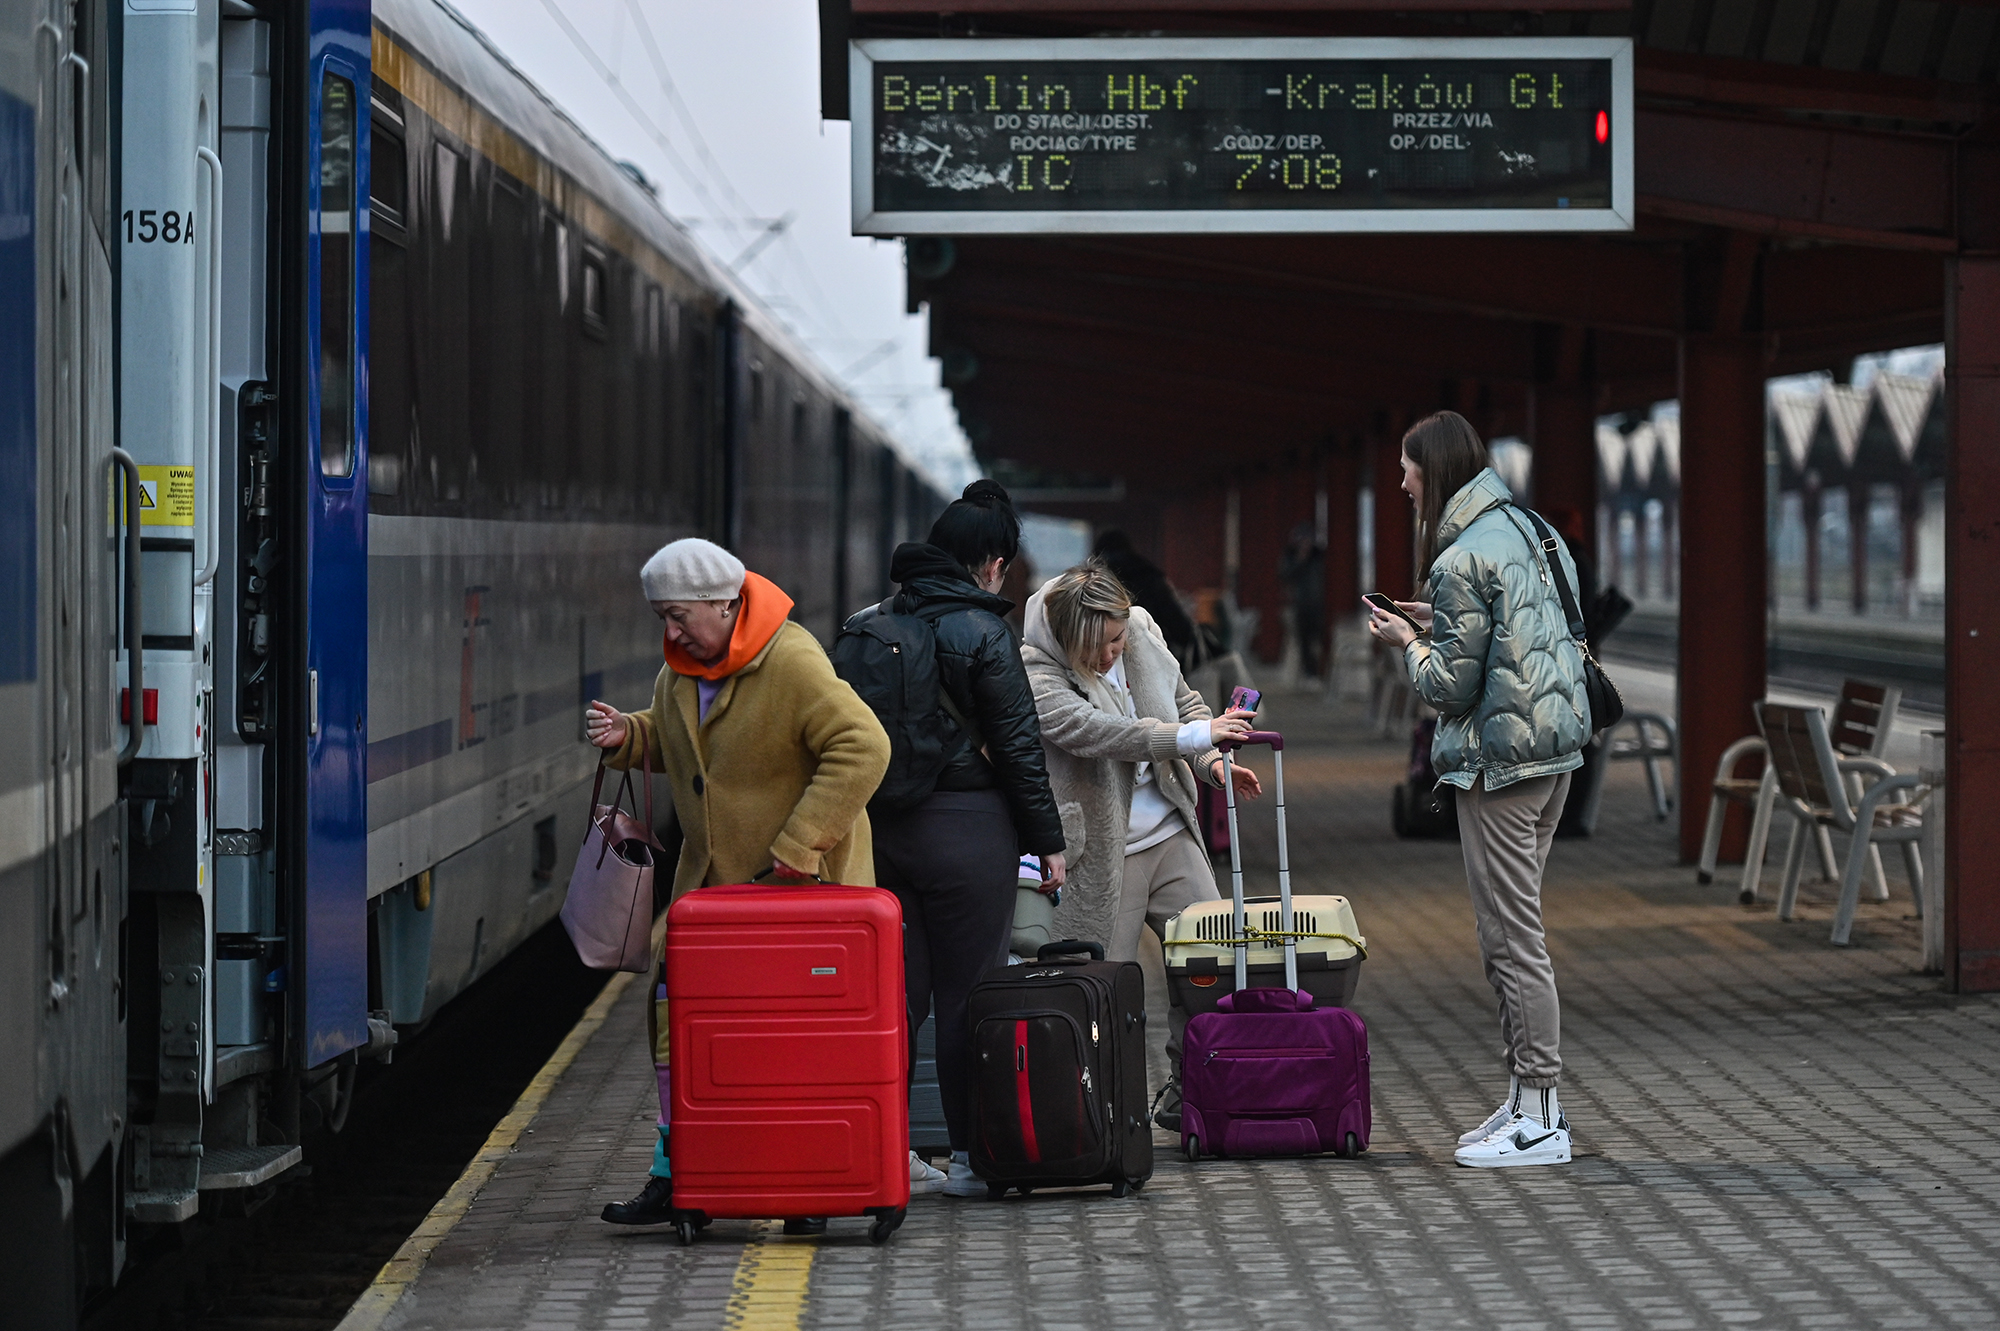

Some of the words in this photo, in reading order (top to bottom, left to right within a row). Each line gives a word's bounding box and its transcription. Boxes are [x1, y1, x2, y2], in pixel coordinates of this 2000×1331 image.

[883, 75, 1071, 111] Berlin
[1107, 74, 1198, 110] Hbf
[994, 114, 1021, 130] DO
[1027, 114, 1152, 130] STACJI/DEST.
[1392, 112, 1494, 128] PRZEZ/VIA
[1222, 134, 1326, 150] GODZ/DEP.
[1016, 154, 1071, 191] IC
[1236, 153, 1341, 190] 7:08
[123, 210, 194, 245] 158A
